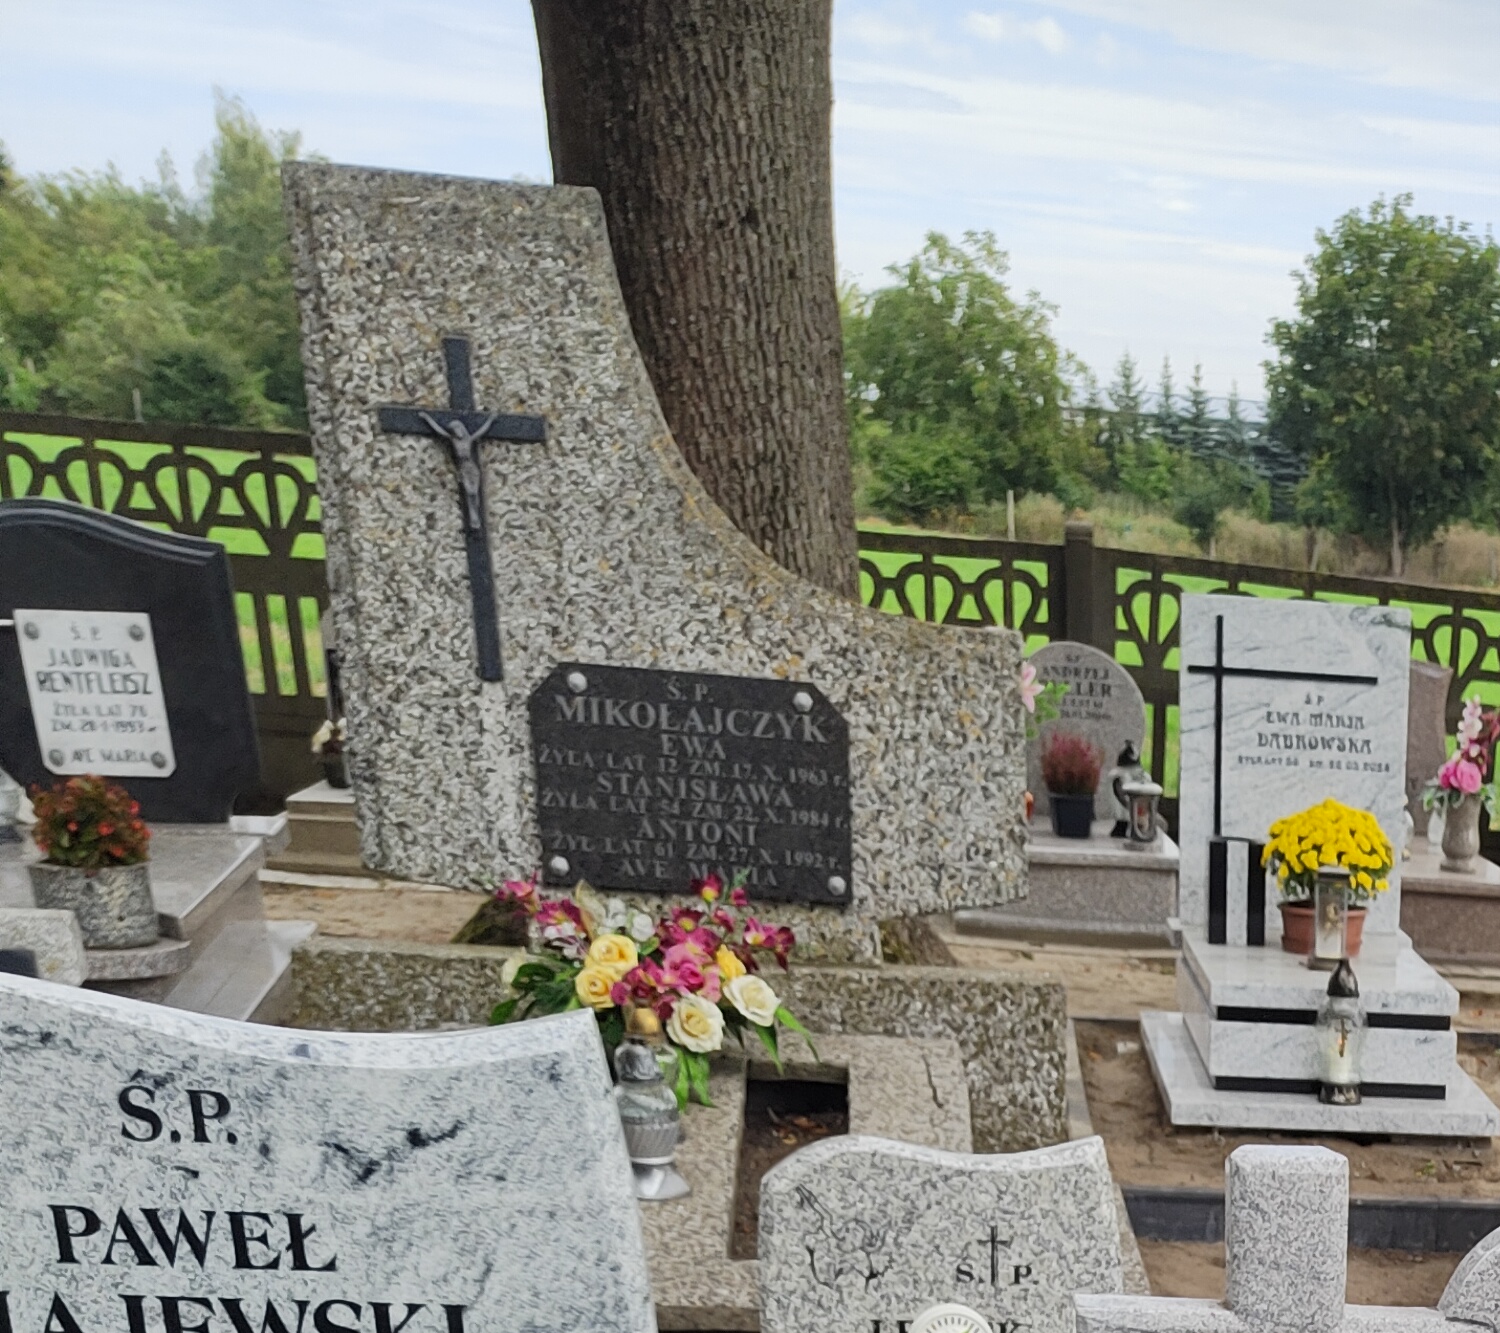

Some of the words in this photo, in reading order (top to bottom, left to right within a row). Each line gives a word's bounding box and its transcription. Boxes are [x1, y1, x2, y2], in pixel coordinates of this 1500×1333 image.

[555, 695, 830, 744] MIKOŁAJCZYK
[606, 752, 647, 771] LAT
[661, 733, 727, 761] EWA
[597, 770, 794, 808] STANISŁAWA
[637, 817, 758, 847] ANTONI
[50, 1202, 339, 1274] PAWEŁ
